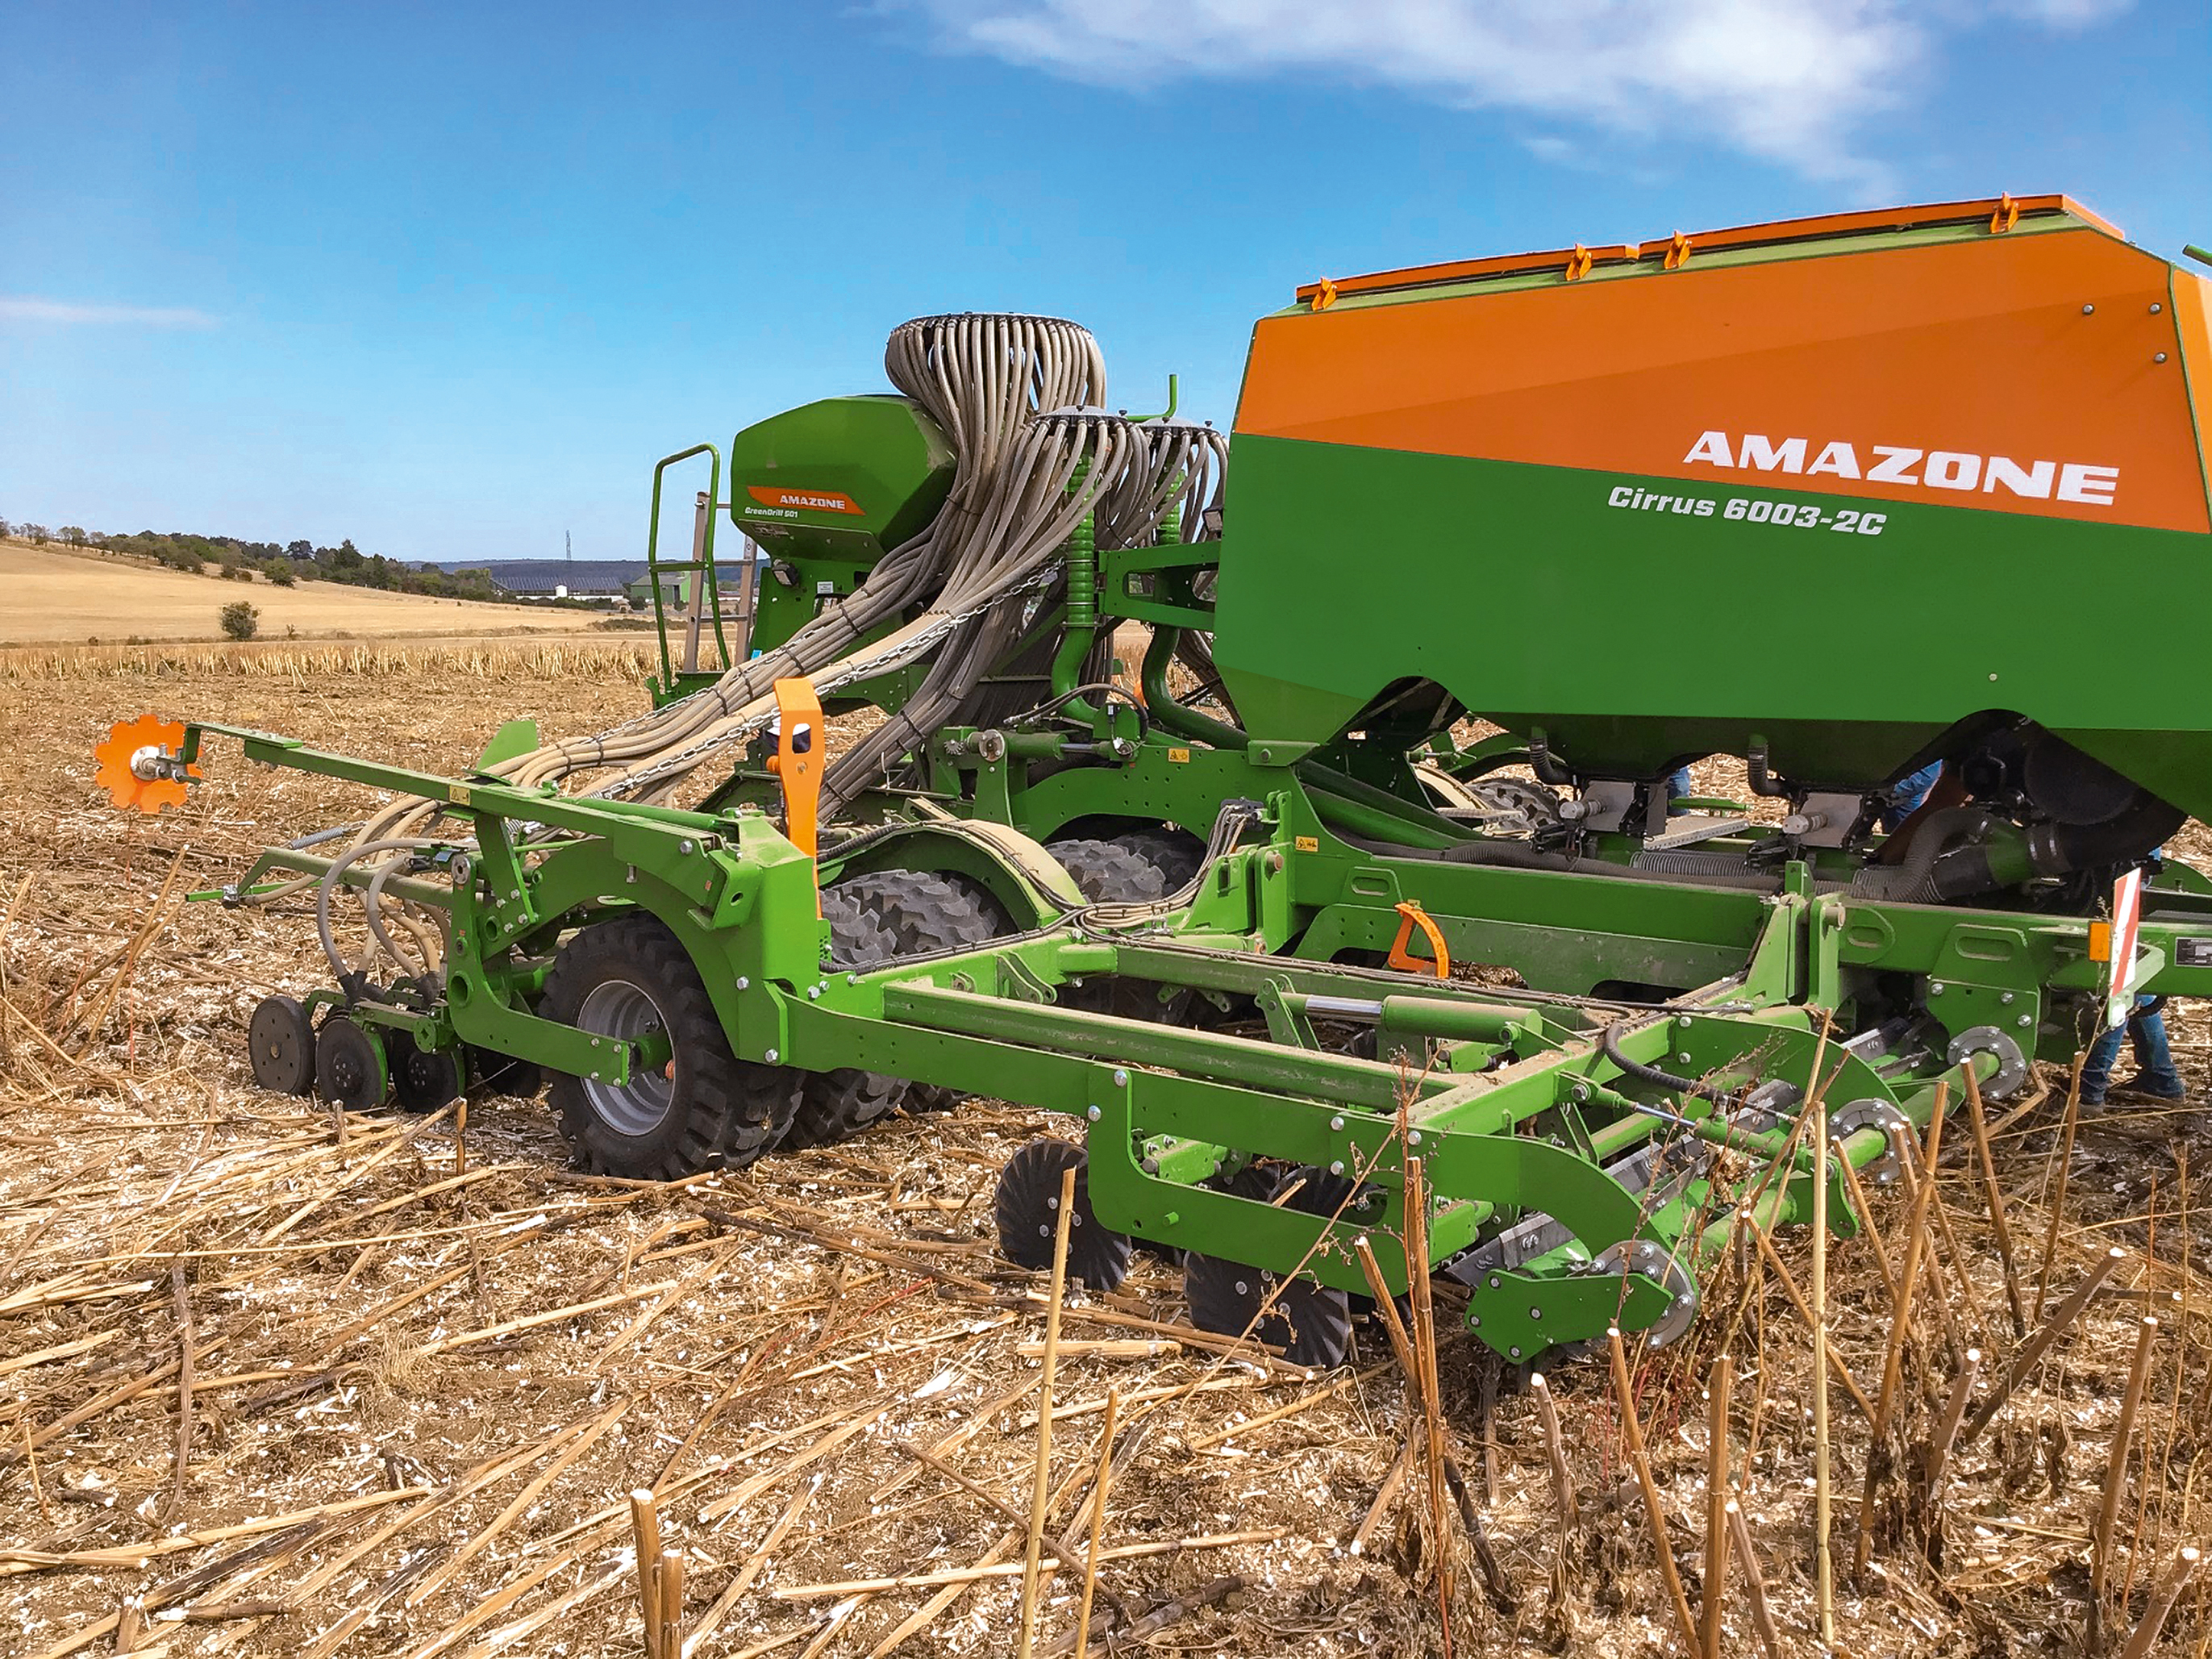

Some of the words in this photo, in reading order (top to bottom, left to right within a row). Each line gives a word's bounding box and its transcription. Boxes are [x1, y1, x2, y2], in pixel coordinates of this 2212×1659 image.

[1682, 430, 2119, 506] AMAZONE
[744, 506, 783, 517] GreenDrill
[780, 495, 845, 510] AMAZONE
[1608, 486, 1716, 516] Cirrus
[1723, 498, 1887, 536] 6003-2C
